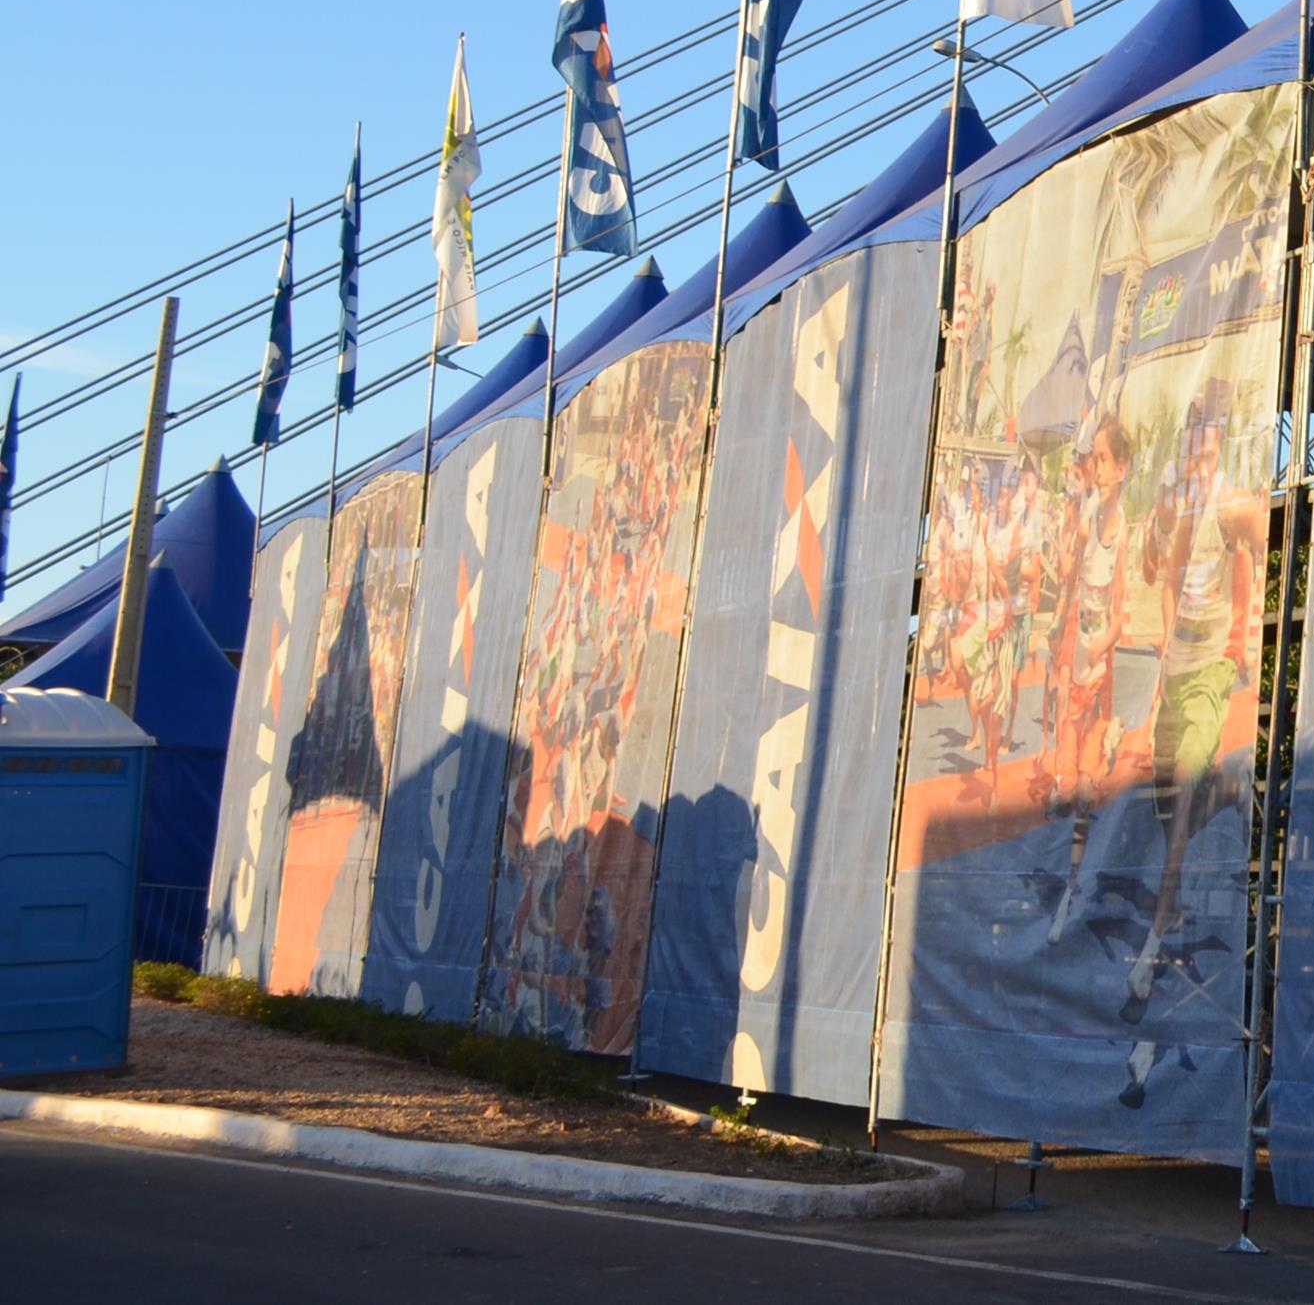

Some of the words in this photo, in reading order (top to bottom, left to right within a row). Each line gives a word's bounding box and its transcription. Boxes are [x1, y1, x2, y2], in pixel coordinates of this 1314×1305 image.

[234, 532, 303, 932] CAIXA
[414, 440, 497, 952] CAIXA
[741, 283, 849, 992] CAIXA
